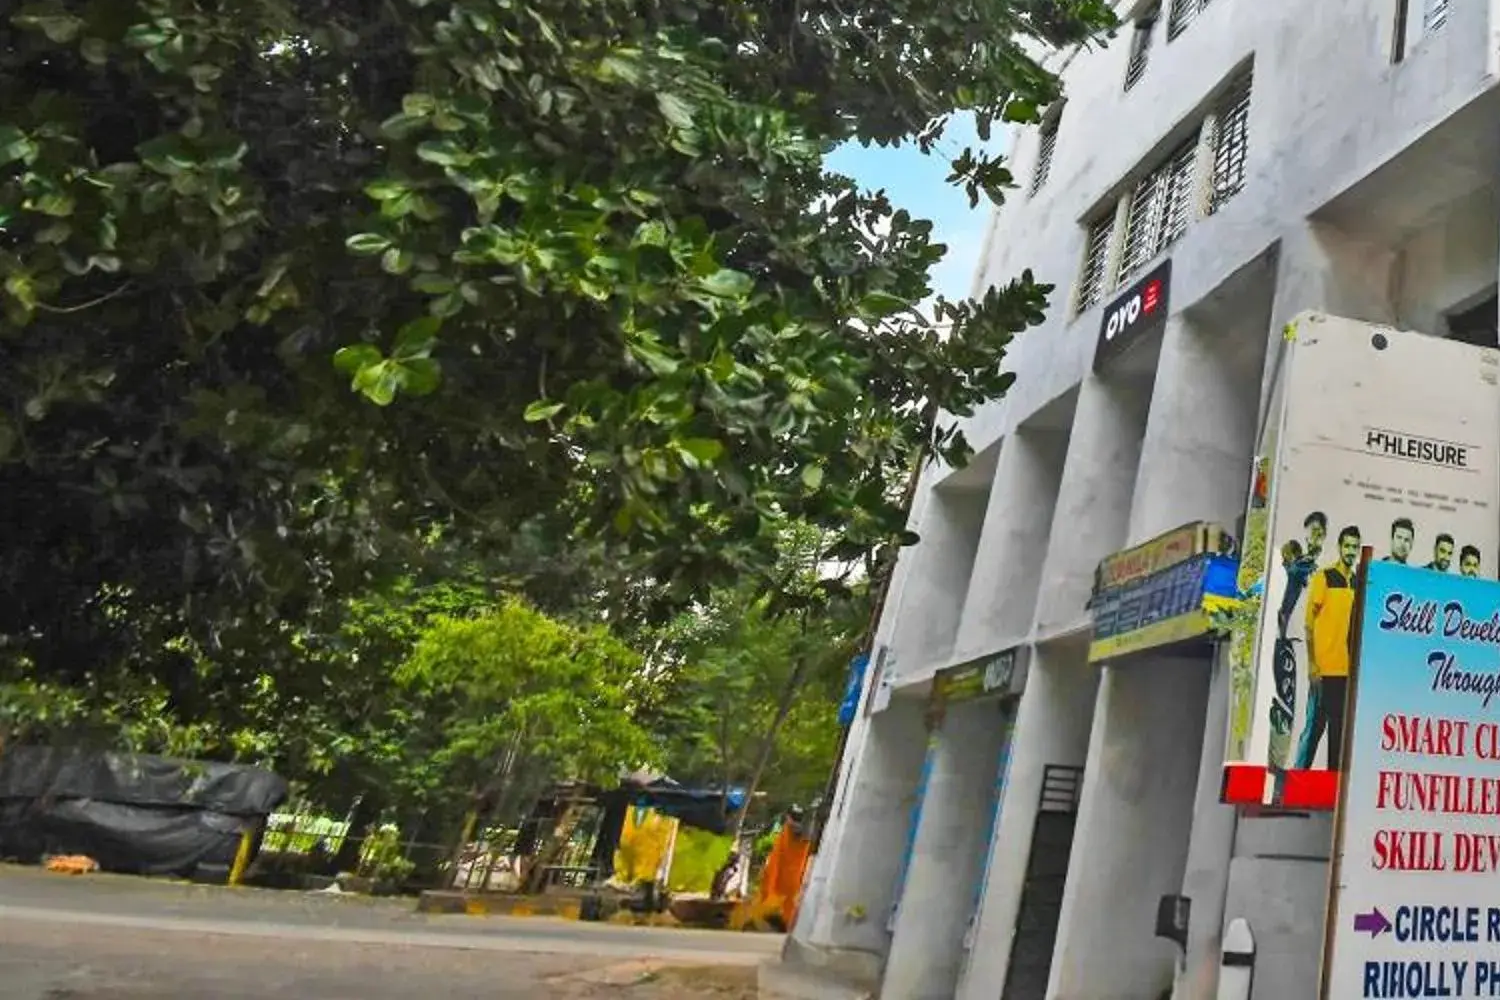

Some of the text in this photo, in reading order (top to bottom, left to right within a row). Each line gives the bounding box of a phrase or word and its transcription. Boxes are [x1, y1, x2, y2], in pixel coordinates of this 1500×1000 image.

[1379, 593, 1437, 635] Skill
[1381, 712, 1470, 760] SMART
[1372, 830, 1447, 873] SKILL
[1395, 905, 1479, 942] CIRCLE
